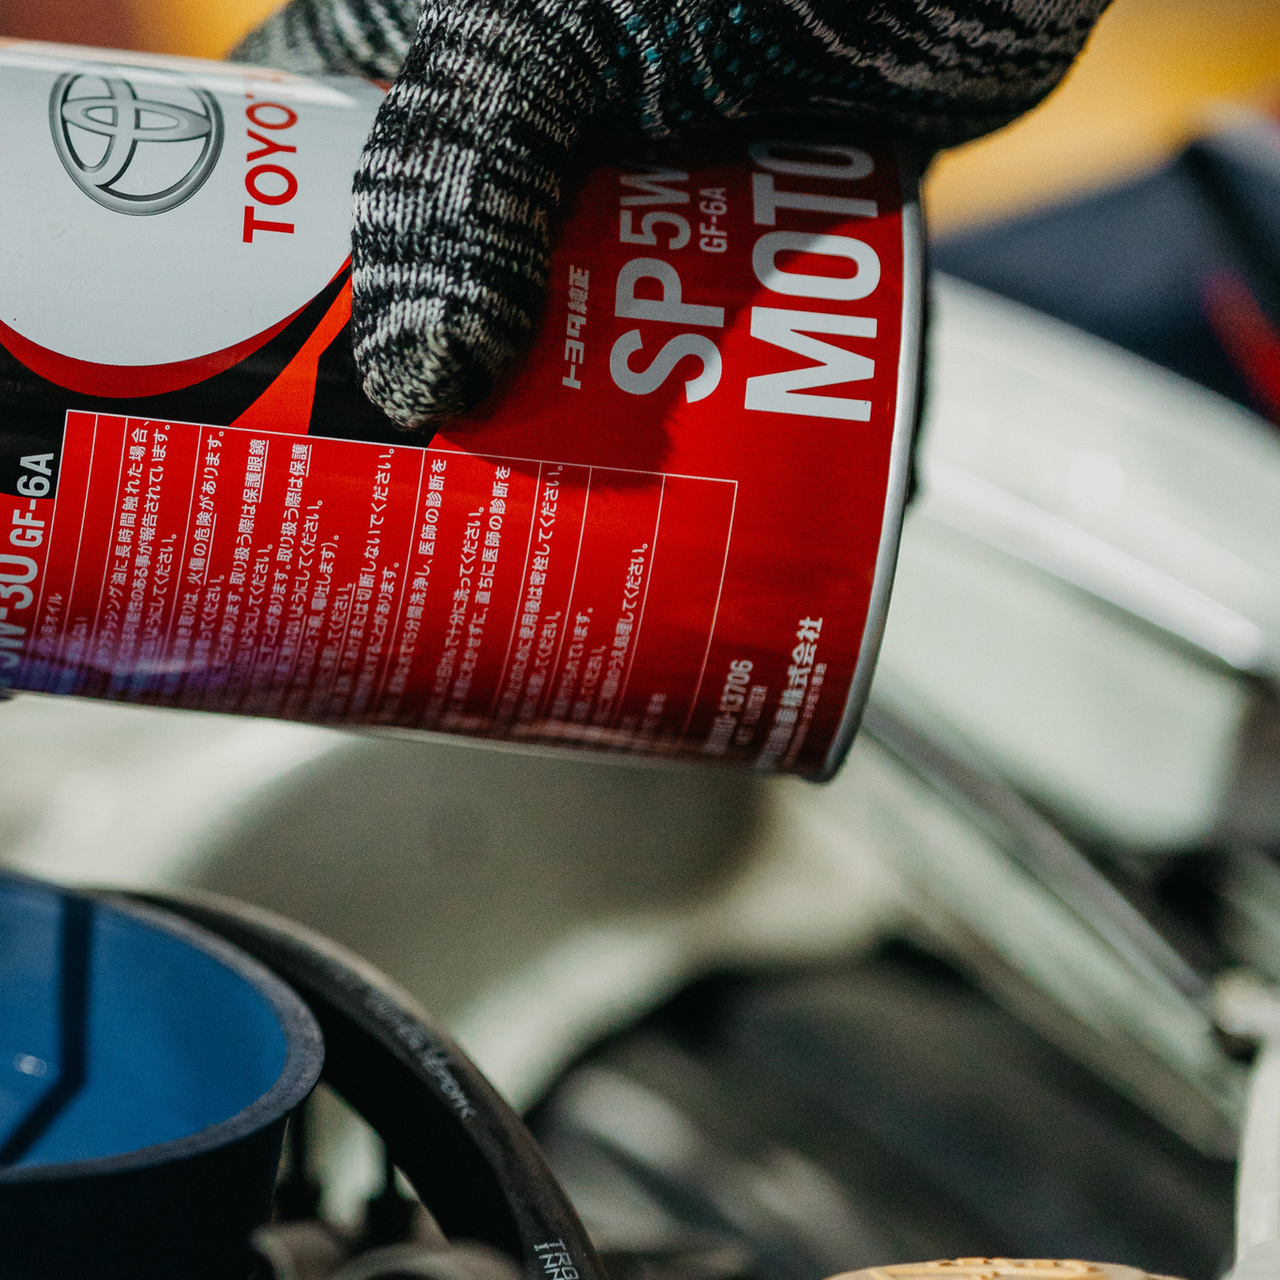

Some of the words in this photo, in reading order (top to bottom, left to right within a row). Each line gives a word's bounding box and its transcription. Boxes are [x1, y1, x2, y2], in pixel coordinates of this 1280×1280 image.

[242, 92, 297, 242] TOYO
[619, 160, 690, 248] 5W
[700, 187, 726, 251] GF-6A
[562, 264, 589, 388] トヨタ純正
[610, 258, 724, 402] SP
[745, 137, 880, 421] MOTO
[8, 448, 54, 549] GF-6A
[95, 419, 149, 668] フラッシング油に長時間触れた場合、
[113, 422, 170, 673] る可能性のある事が報告されています。
[171, 428, 224, 667] き取りは、火傷の危険があります。
